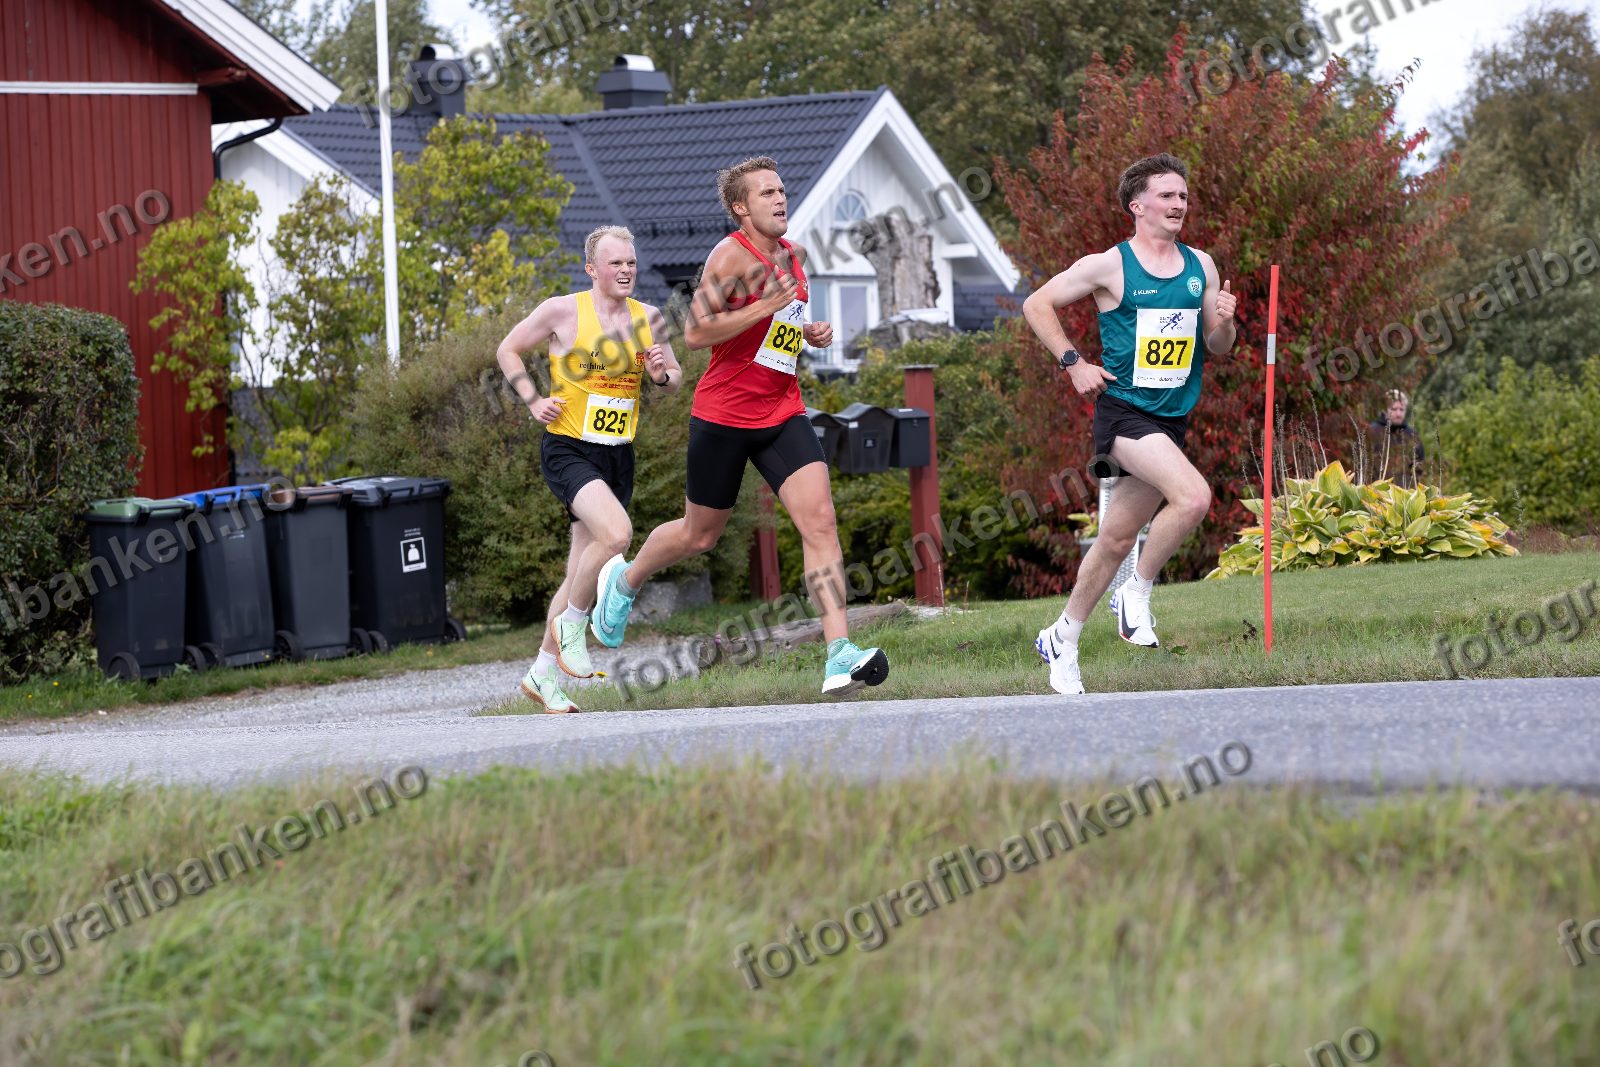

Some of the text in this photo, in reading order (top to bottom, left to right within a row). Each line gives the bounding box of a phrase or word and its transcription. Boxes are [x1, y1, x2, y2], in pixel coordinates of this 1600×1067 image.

[773, 324, 802, 353] 823
[1146, 339, 1188, 366] 827
[593, 408, 628, 435] 825
